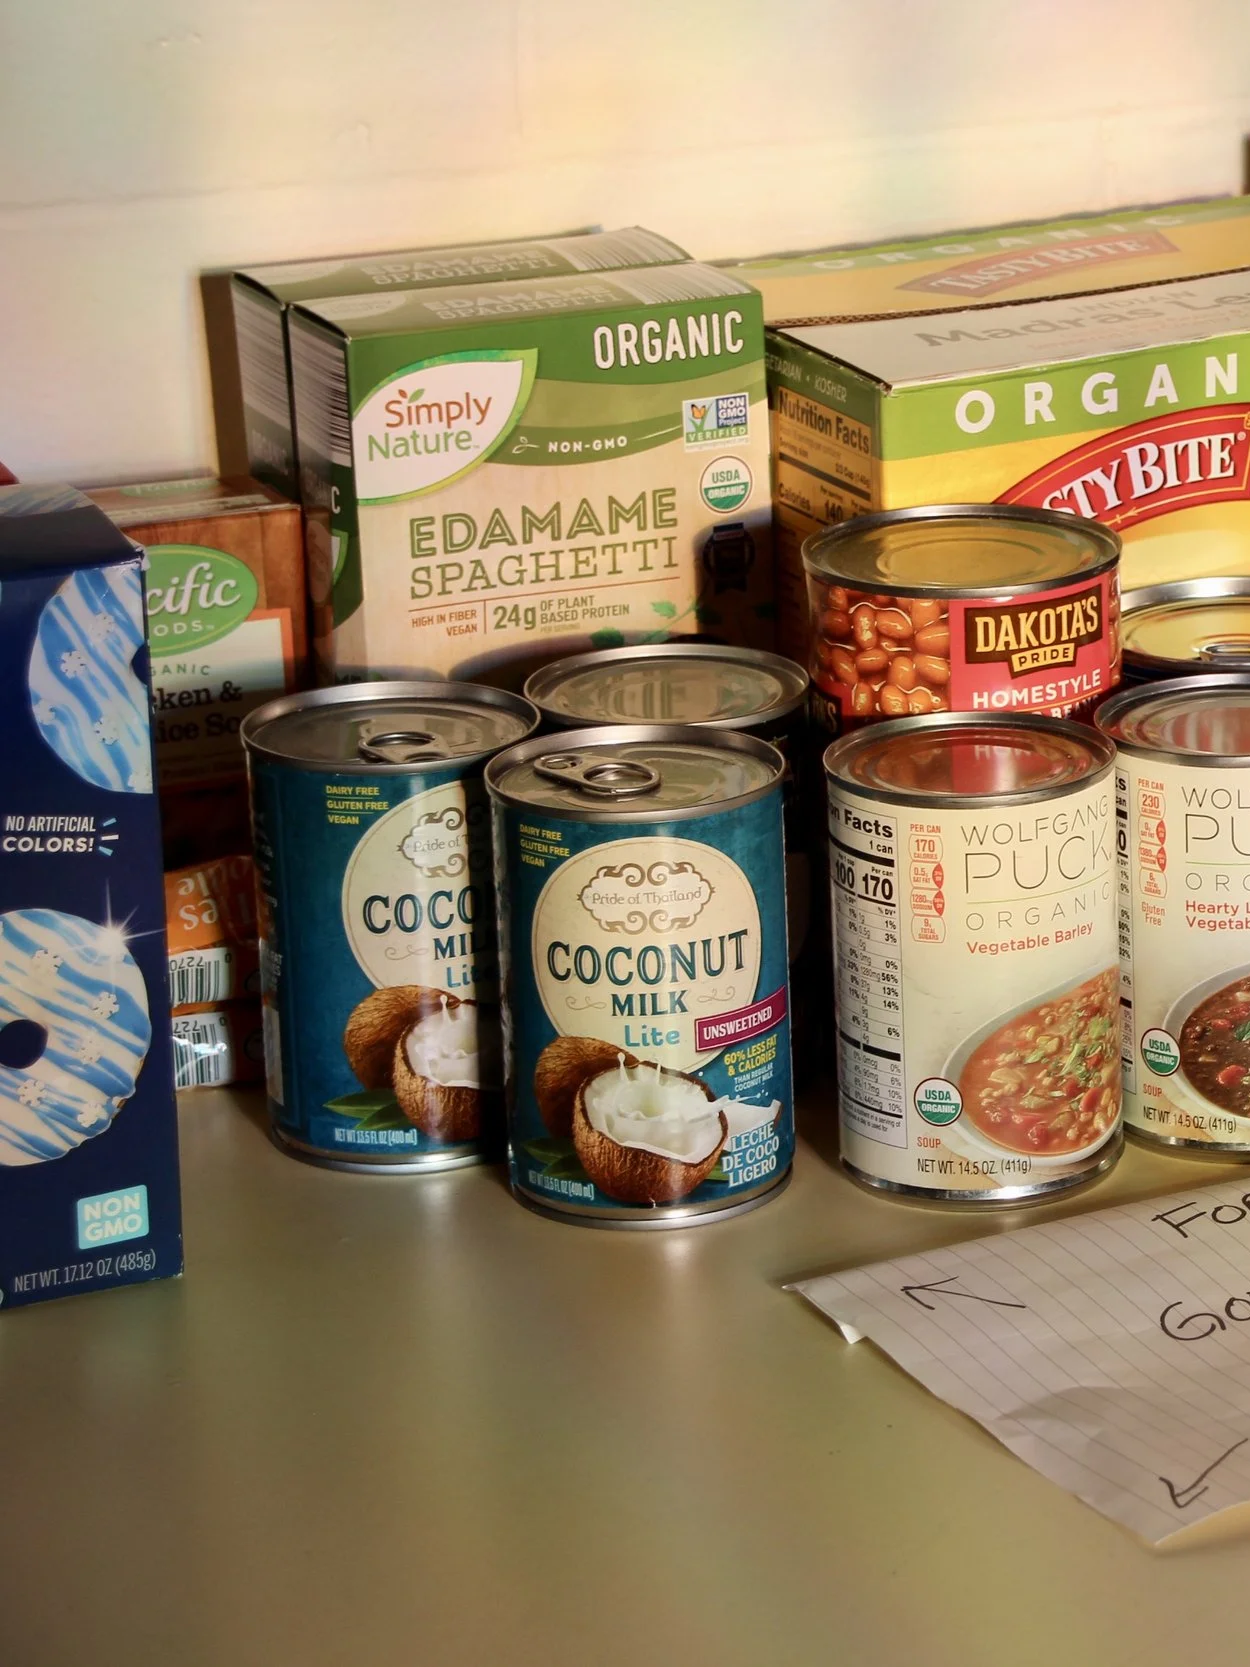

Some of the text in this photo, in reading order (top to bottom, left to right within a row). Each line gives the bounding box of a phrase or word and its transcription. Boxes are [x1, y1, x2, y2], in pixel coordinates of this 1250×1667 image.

[914, 307, 1166, 348] Madras
[592, 311, 744, 370] ORGANIC
[384, 391, 492, 428] Simply
[718, 395, 745, 408] NON
[718, 406, 746, 419] GMO
[779, 389, 832, 436] Nutrition
[836, 415, 870, 454] Facts
[368, 427, 473, 462] Nature
[548, 435, 628, 453] NON-GMO
[688, 427, 747, 442] VERIFIED
[712, 469, 740, 483] USDA
[707, 485, 745, 499] ORGANIC
[409, 486, 678, 559] EDAMAME
[410, 535, 680, 600] SPAGHETTI
[540, 595, 595, 612] OF PLANT
[540, 604, 630, 624] BASED PROTEIN
[412, 609, 477, 628] HIGH IN FIBER
[493, 604, 536, 631] 24g
[975, 596, 1098, 653] DAKOTA'S
[446, 624, 478, 636] VEGAN
[1018, 647, 1071, 668] PRIDE
[972, 669, 1101, 710] HOMESTYLE
[326, 785, 380, 797] DAIRY FREE
[1142, 794, 1160, 809] 230
[327, 799, 389, 811] GLUTEN FREE
[6, 815, 96, 833] NO ARTIFICIAL
[328, 814, 359, 825] VEGAN
[844, 808, 893, 838] Facts
[960, 794, 1110, 847] WOLFGANG
[3, 835, 94, 853] COLORS!
[915, 840, 935, 852] 170
[964, 821, 1110, 894] PUCK
[835, 859, 893, 900] 100 170
[592, 888, 702, 906] Pride of Thailand
[965, 880, 1110, 931] ORGANIC
[1186, 901, 1240, 916] Hearty
[363, 889, 482, 935] COCO
[1142, 902, 1165, 916] Gluten
[1145, 913, 1161, 926] Free
[966, 921, 1095, 957] Vegetable Barley
[546, 928, 749, 987] COCONUT
[611, 989, 689, 1018] MILK
[703, 1006, 772, 1040] UNSWEETENED
[624, 1025, 680, 1048] Lite
[1148, 1038, 1172, 1053] USDA
[724, 1034, 777, 1066] 60% LESS FAT
[728, 1048, 776, 1076] & CALORIES
[924, 1088, 953, 1102] USDA
[1143, 1083, 1162, 1098] SOUP
[920, 1101, 957, 1115] ORGANIC
[731, 1121, 775, 1152] LECHE
[917, 1135, 941, 1149] SOUP
[722, 1136, 780, 1173] DE COCO
[917, 1155, 1032, 1177] NET WT. 14.5 OZ. (411g)
[728, 1155, 777, 1188] LIGERO
[84, 1192, 141, 1222] NON
[85, 1215, 143, 1242] GMO
[14, 1249, 156, 1293] NET WT. 17.12 OZ (485g)
